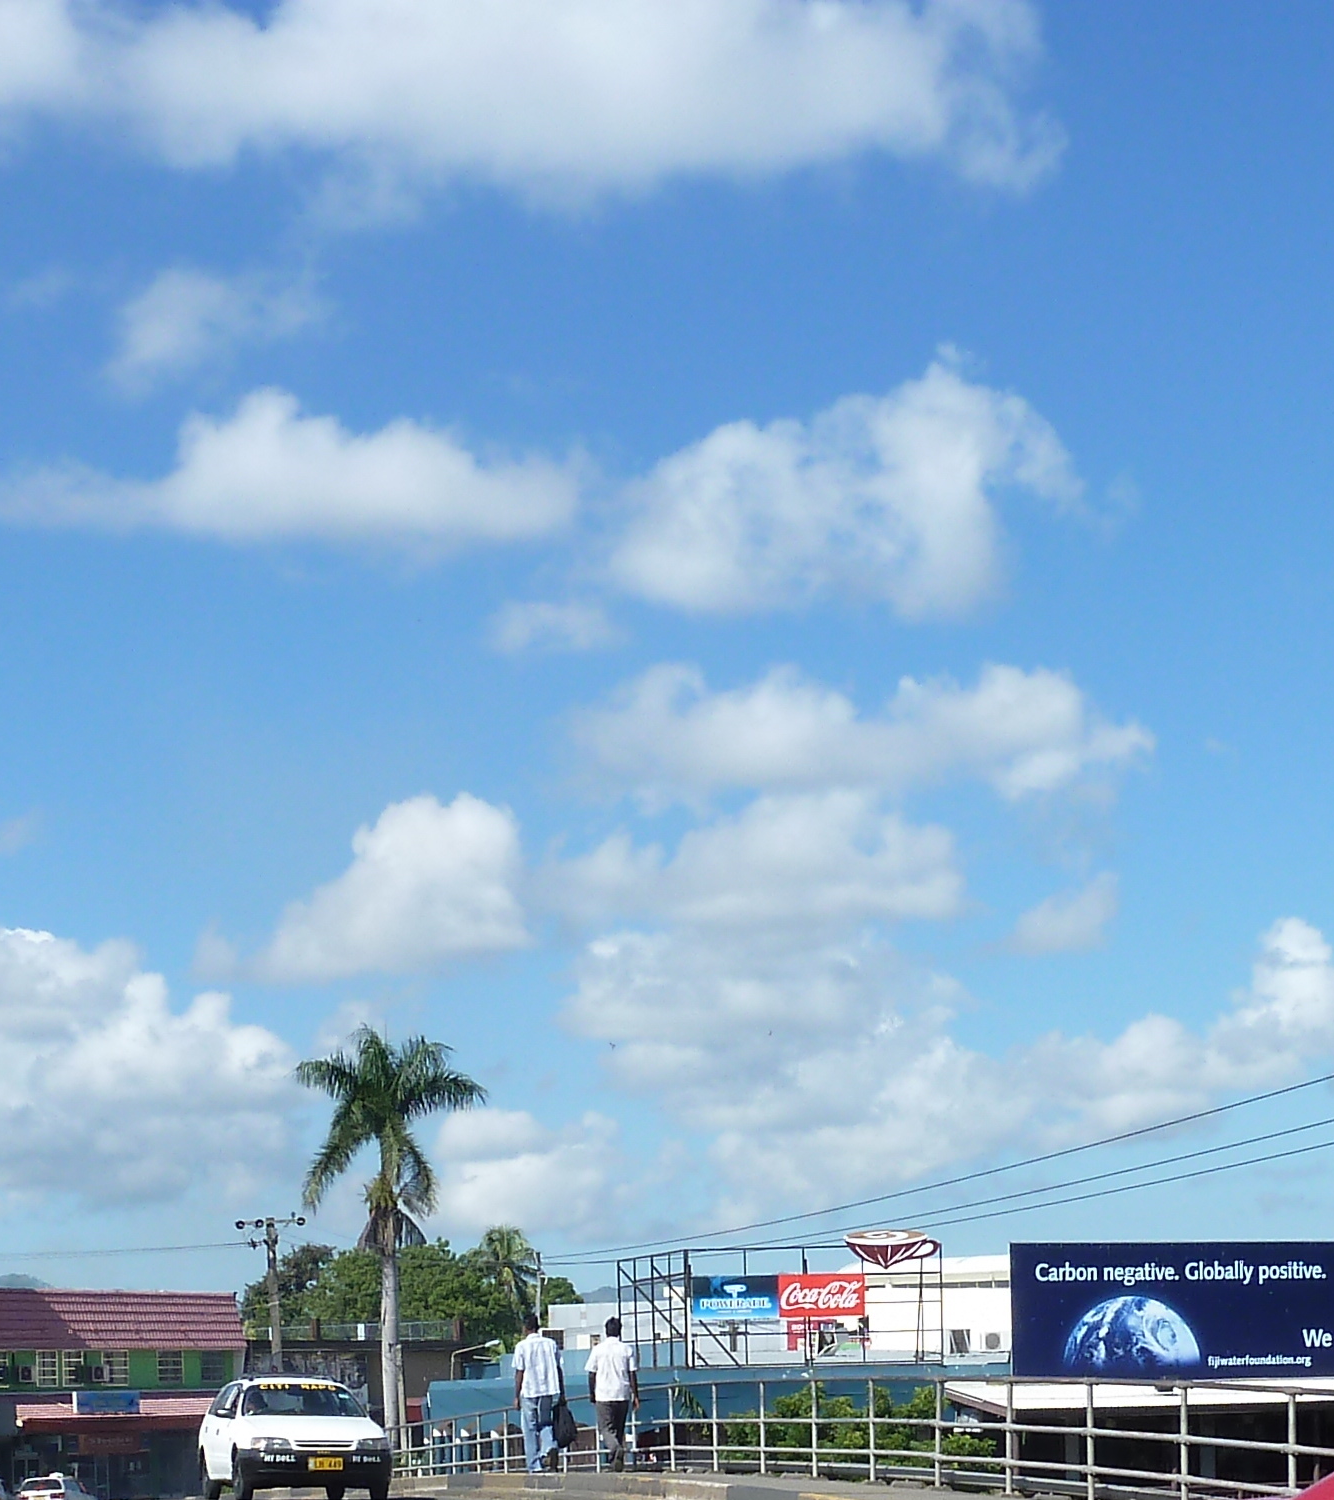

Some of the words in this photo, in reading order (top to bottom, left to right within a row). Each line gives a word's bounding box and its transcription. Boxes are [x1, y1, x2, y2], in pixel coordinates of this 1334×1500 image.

[1034, 1261, 1098, 1282] Carbon
[1103, 1262, 1180, 1286] negative.
[1184, 1260, 1255, 1285] Globally
[1258, 1261, 1327, 1285] positive.
[1302, 1328, 1333, 1347] We
[1207, 1354, 1312, 1369] fijiwaterfoundation.org
